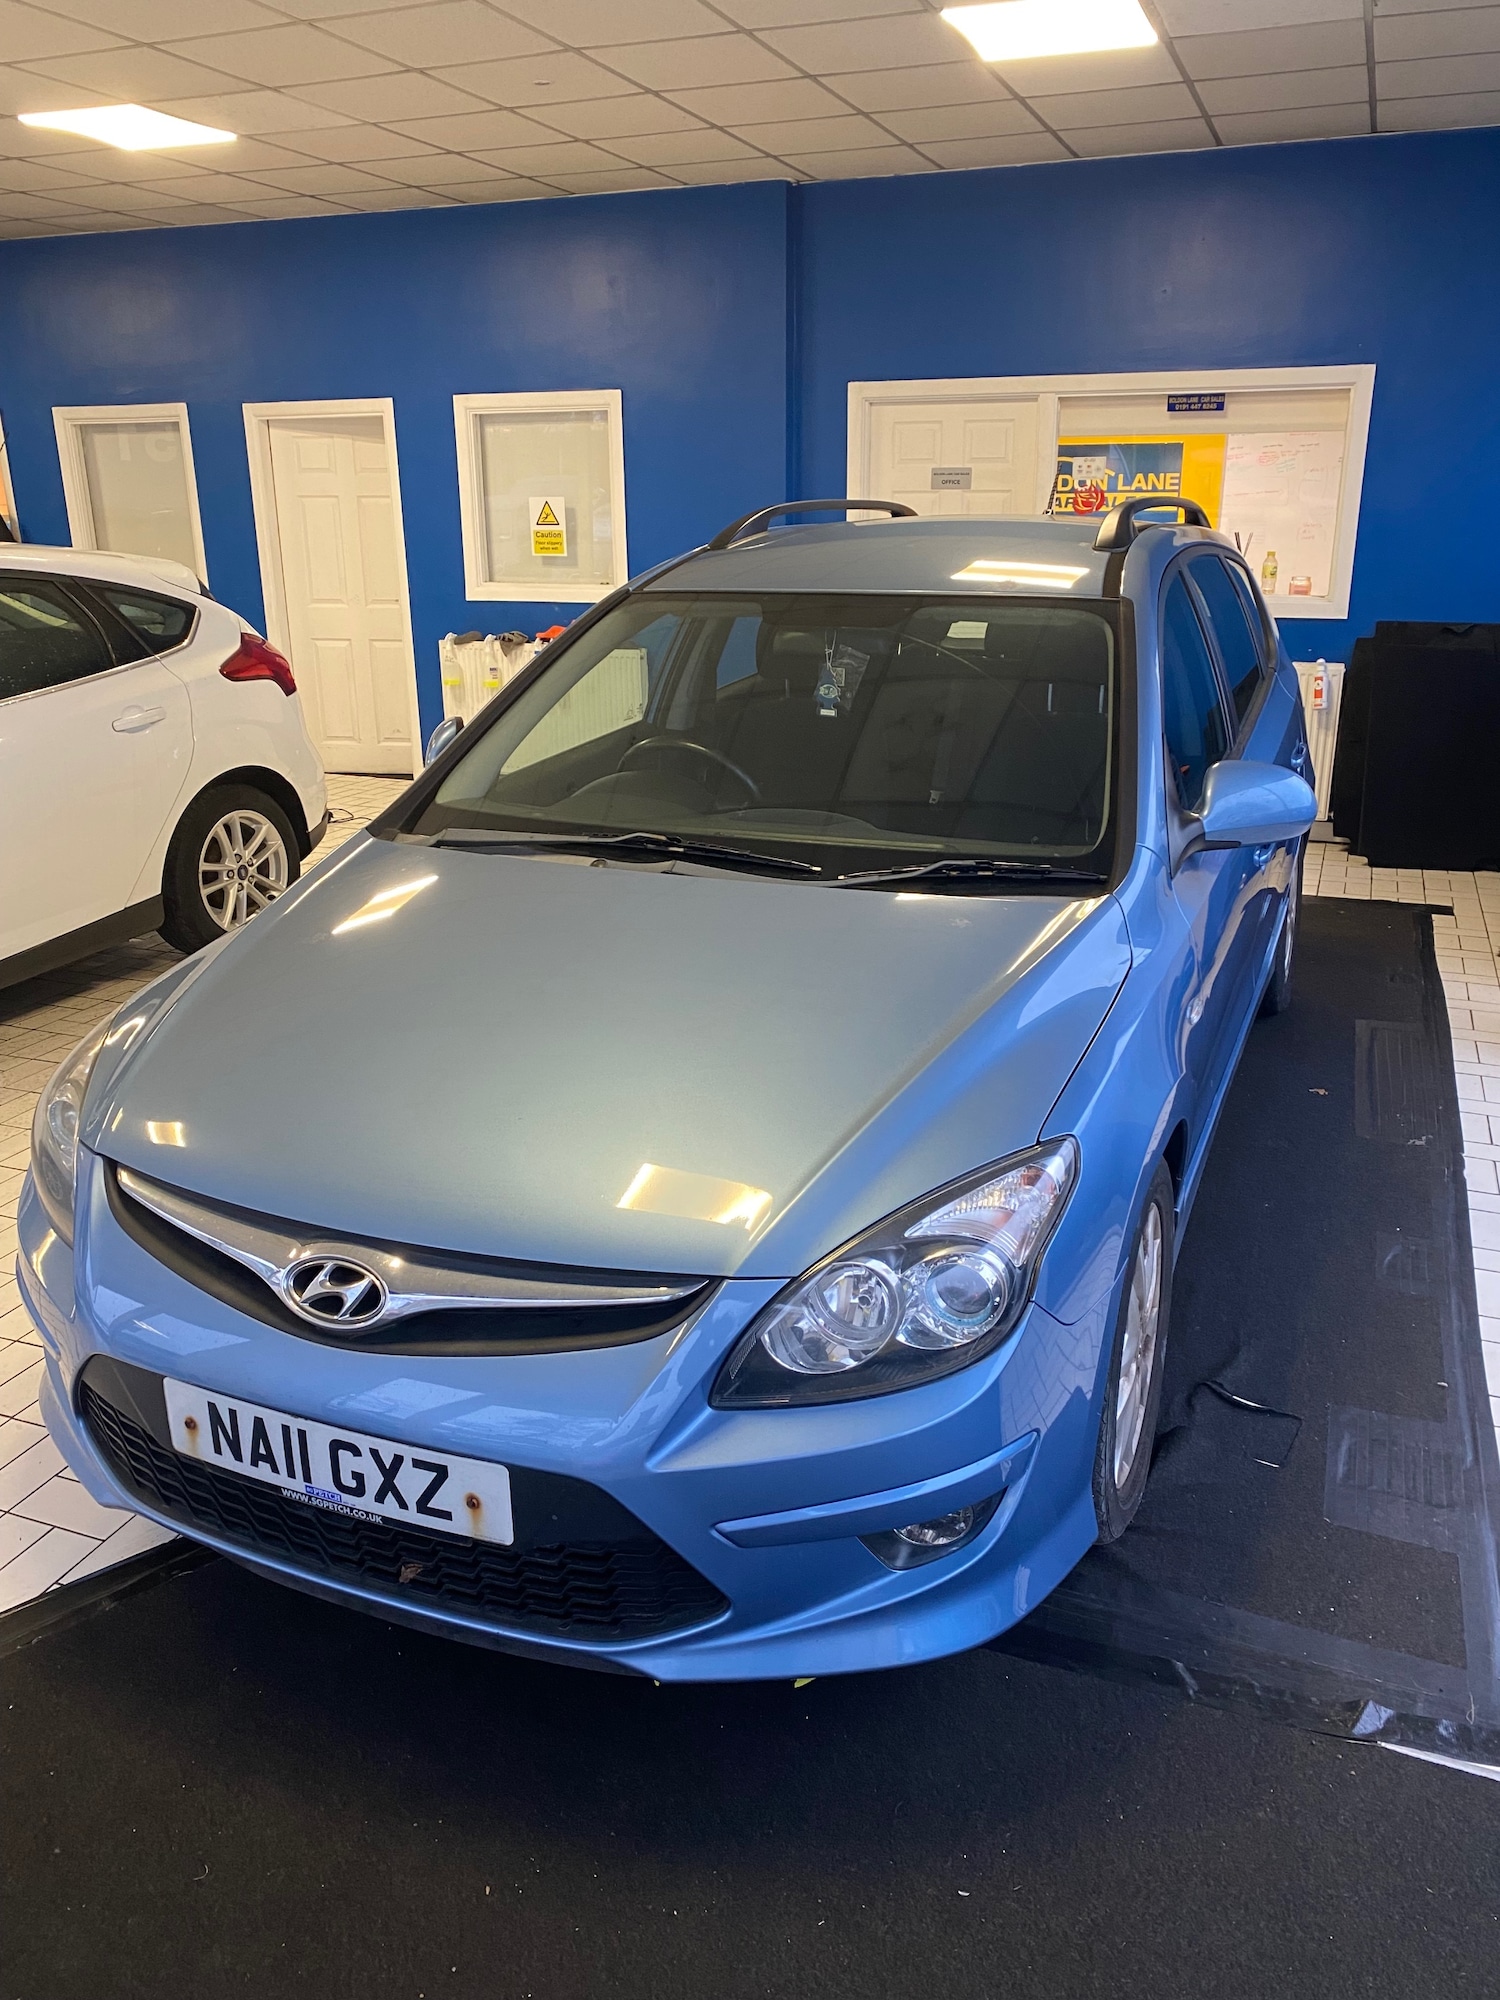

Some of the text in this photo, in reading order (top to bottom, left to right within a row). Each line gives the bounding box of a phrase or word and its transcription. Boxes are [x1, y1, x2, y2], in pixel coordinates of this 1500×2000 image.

[1117, 472, 1180, 491] LANE
[207, 1401, 453, 1522] NA11 GXZ
[281, 1487, 383, 1524] WWW.SGPETCH.CO.UK
